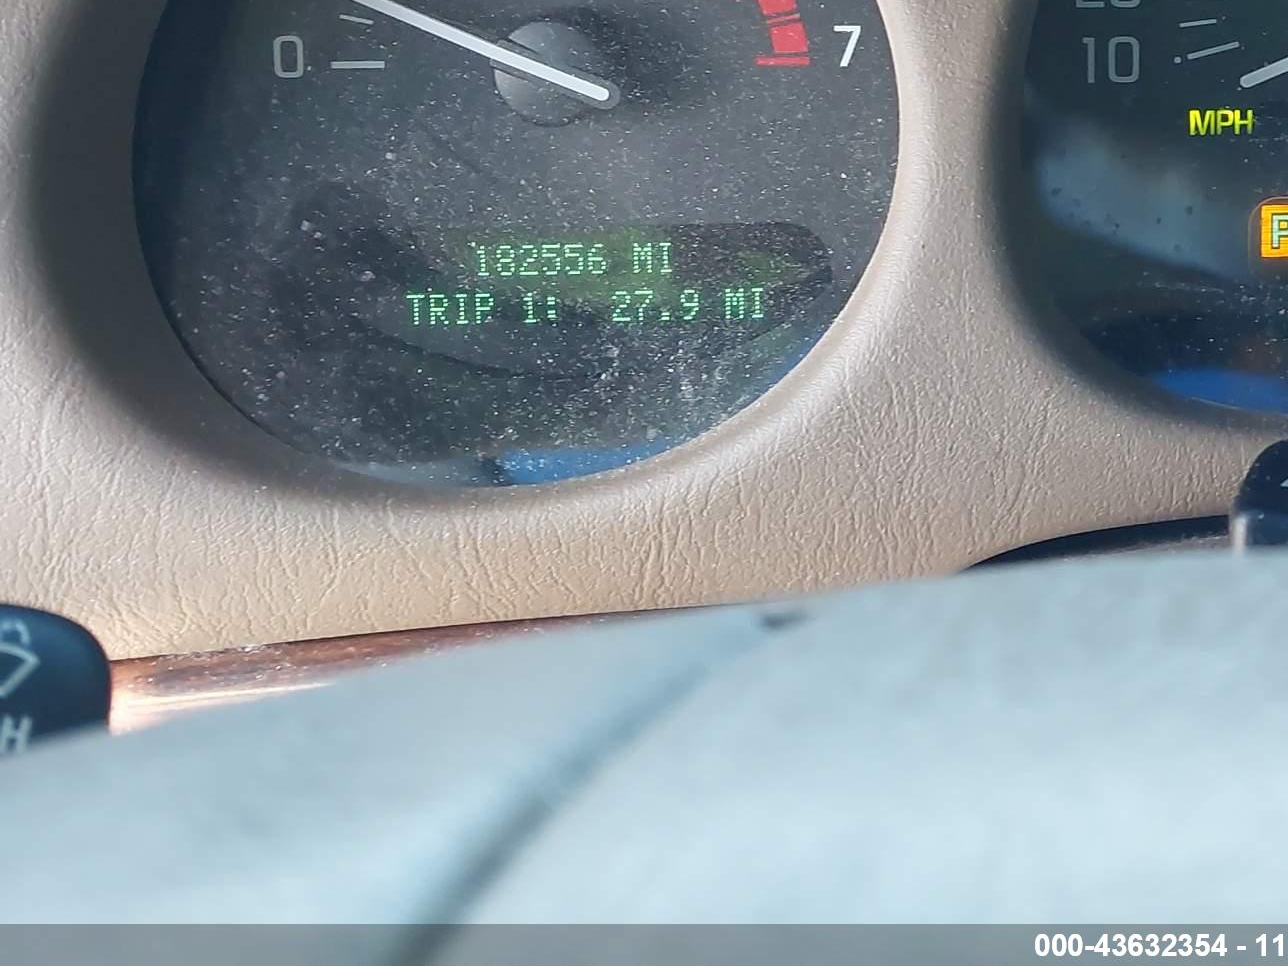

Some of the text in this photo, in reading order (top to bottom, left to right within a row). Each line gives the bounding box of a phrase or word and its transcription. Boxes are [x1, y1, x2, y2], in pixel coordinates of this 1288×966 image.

[274, 36, 303, 78] 0
[834, 26, 860, 66] 7
[1083, 37, 1139, 83] 10
[1190, 110, 1252, 135] MPH
[474, 243, 672, 276] 182556 MI
[407, 288, 763, 324] TRIP 1: 27.9 MI
